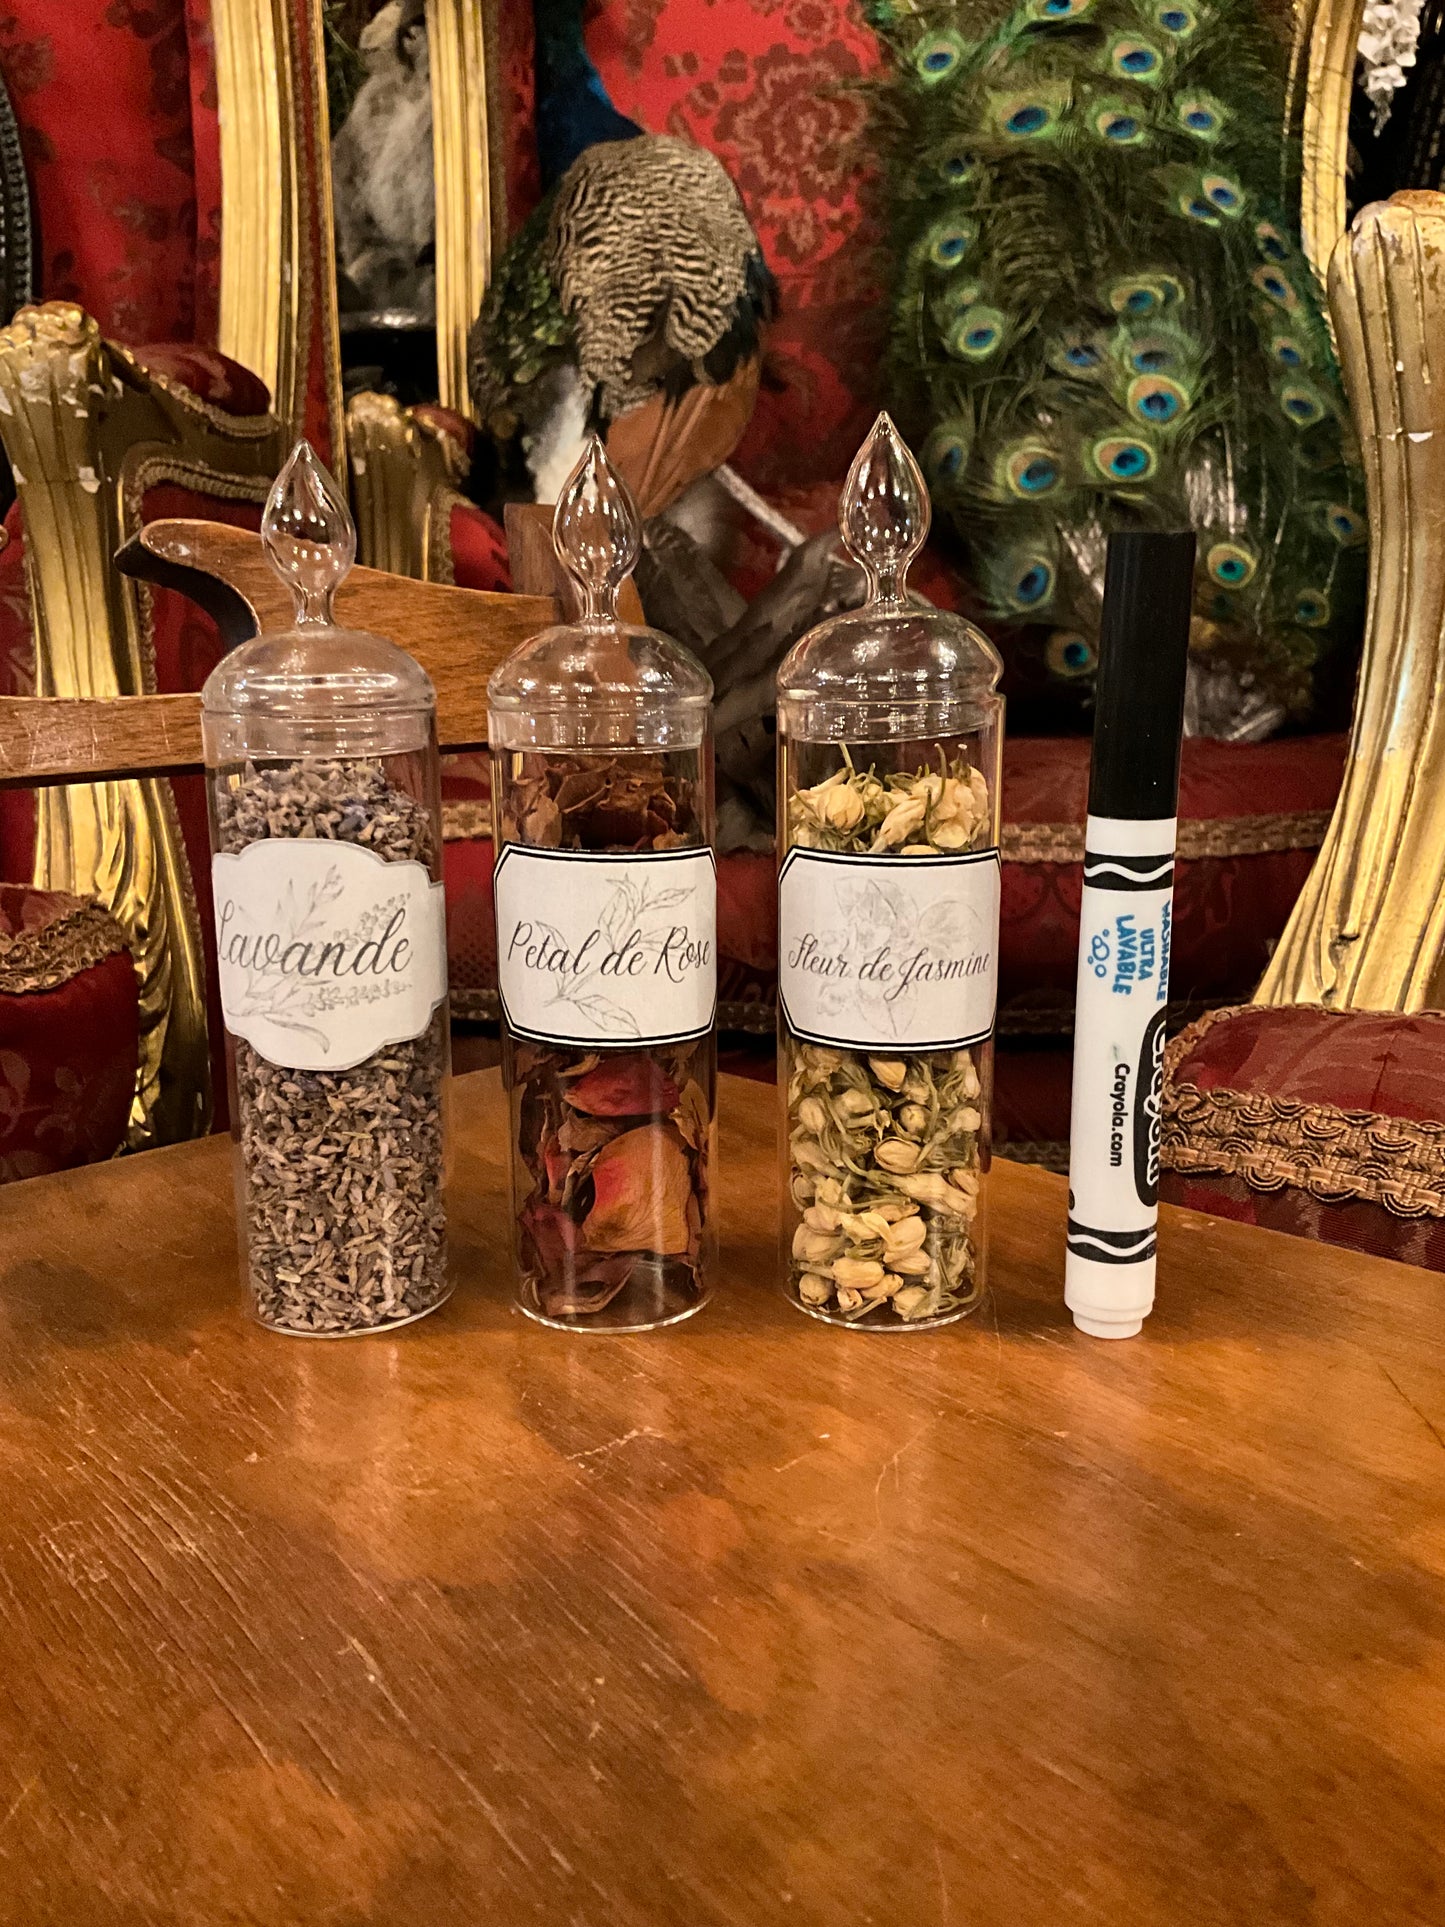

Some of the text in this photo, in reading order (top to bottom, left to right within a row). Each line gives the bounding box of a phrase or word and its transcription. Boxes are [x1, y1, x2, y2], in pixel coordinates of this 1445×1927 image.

[507, 920, 711, 983] Petal de Rose
[788, 932, 990, 1001] Fleur de Jasmine
[1112, 913, 1138, 996] LAVABLE
[1138, 927, 1155, 981] ULTRA
[1109, 1062, 1131, 1167] Crayola.com
